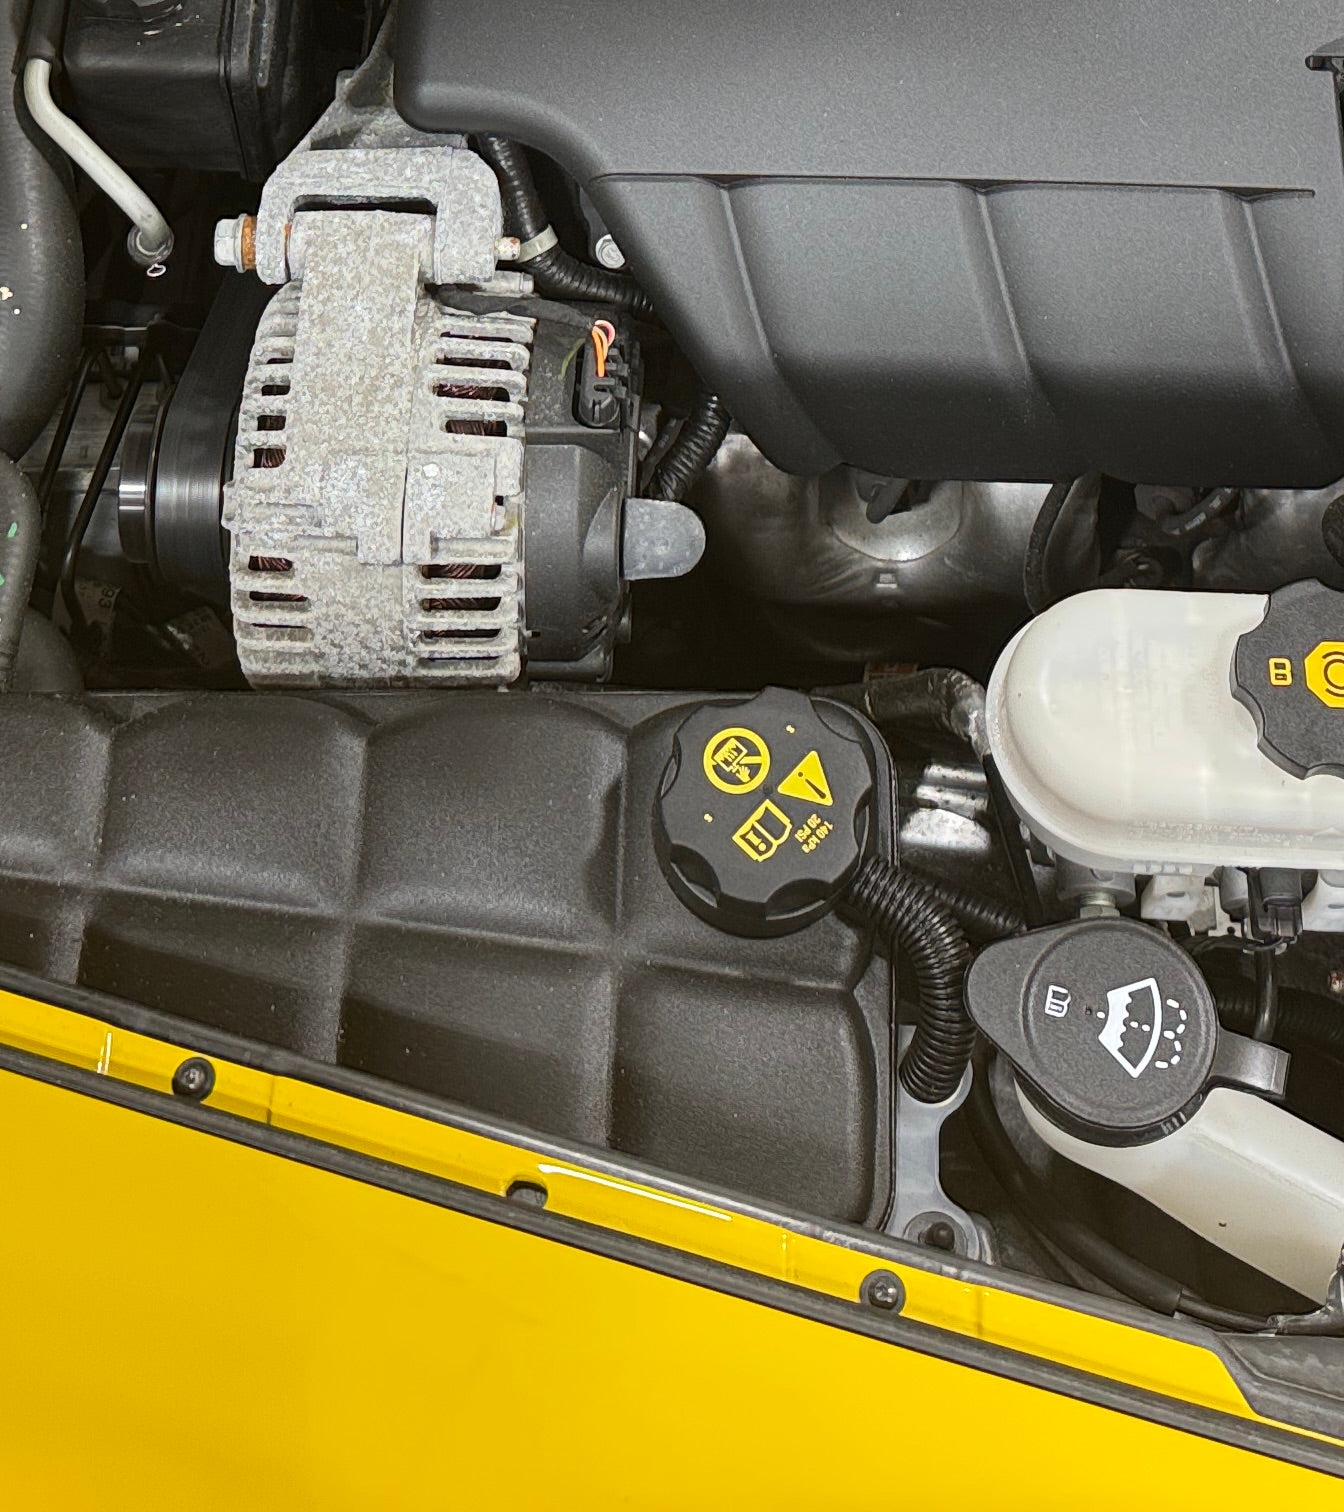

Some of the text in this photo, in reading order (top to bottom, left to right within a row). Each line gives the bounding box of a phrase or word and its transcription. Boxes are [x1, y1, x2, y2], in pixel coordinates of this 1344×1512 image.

[794, 813, 822, 842] 20 PSI
[802, 821, 834, 854] 140 kPa
